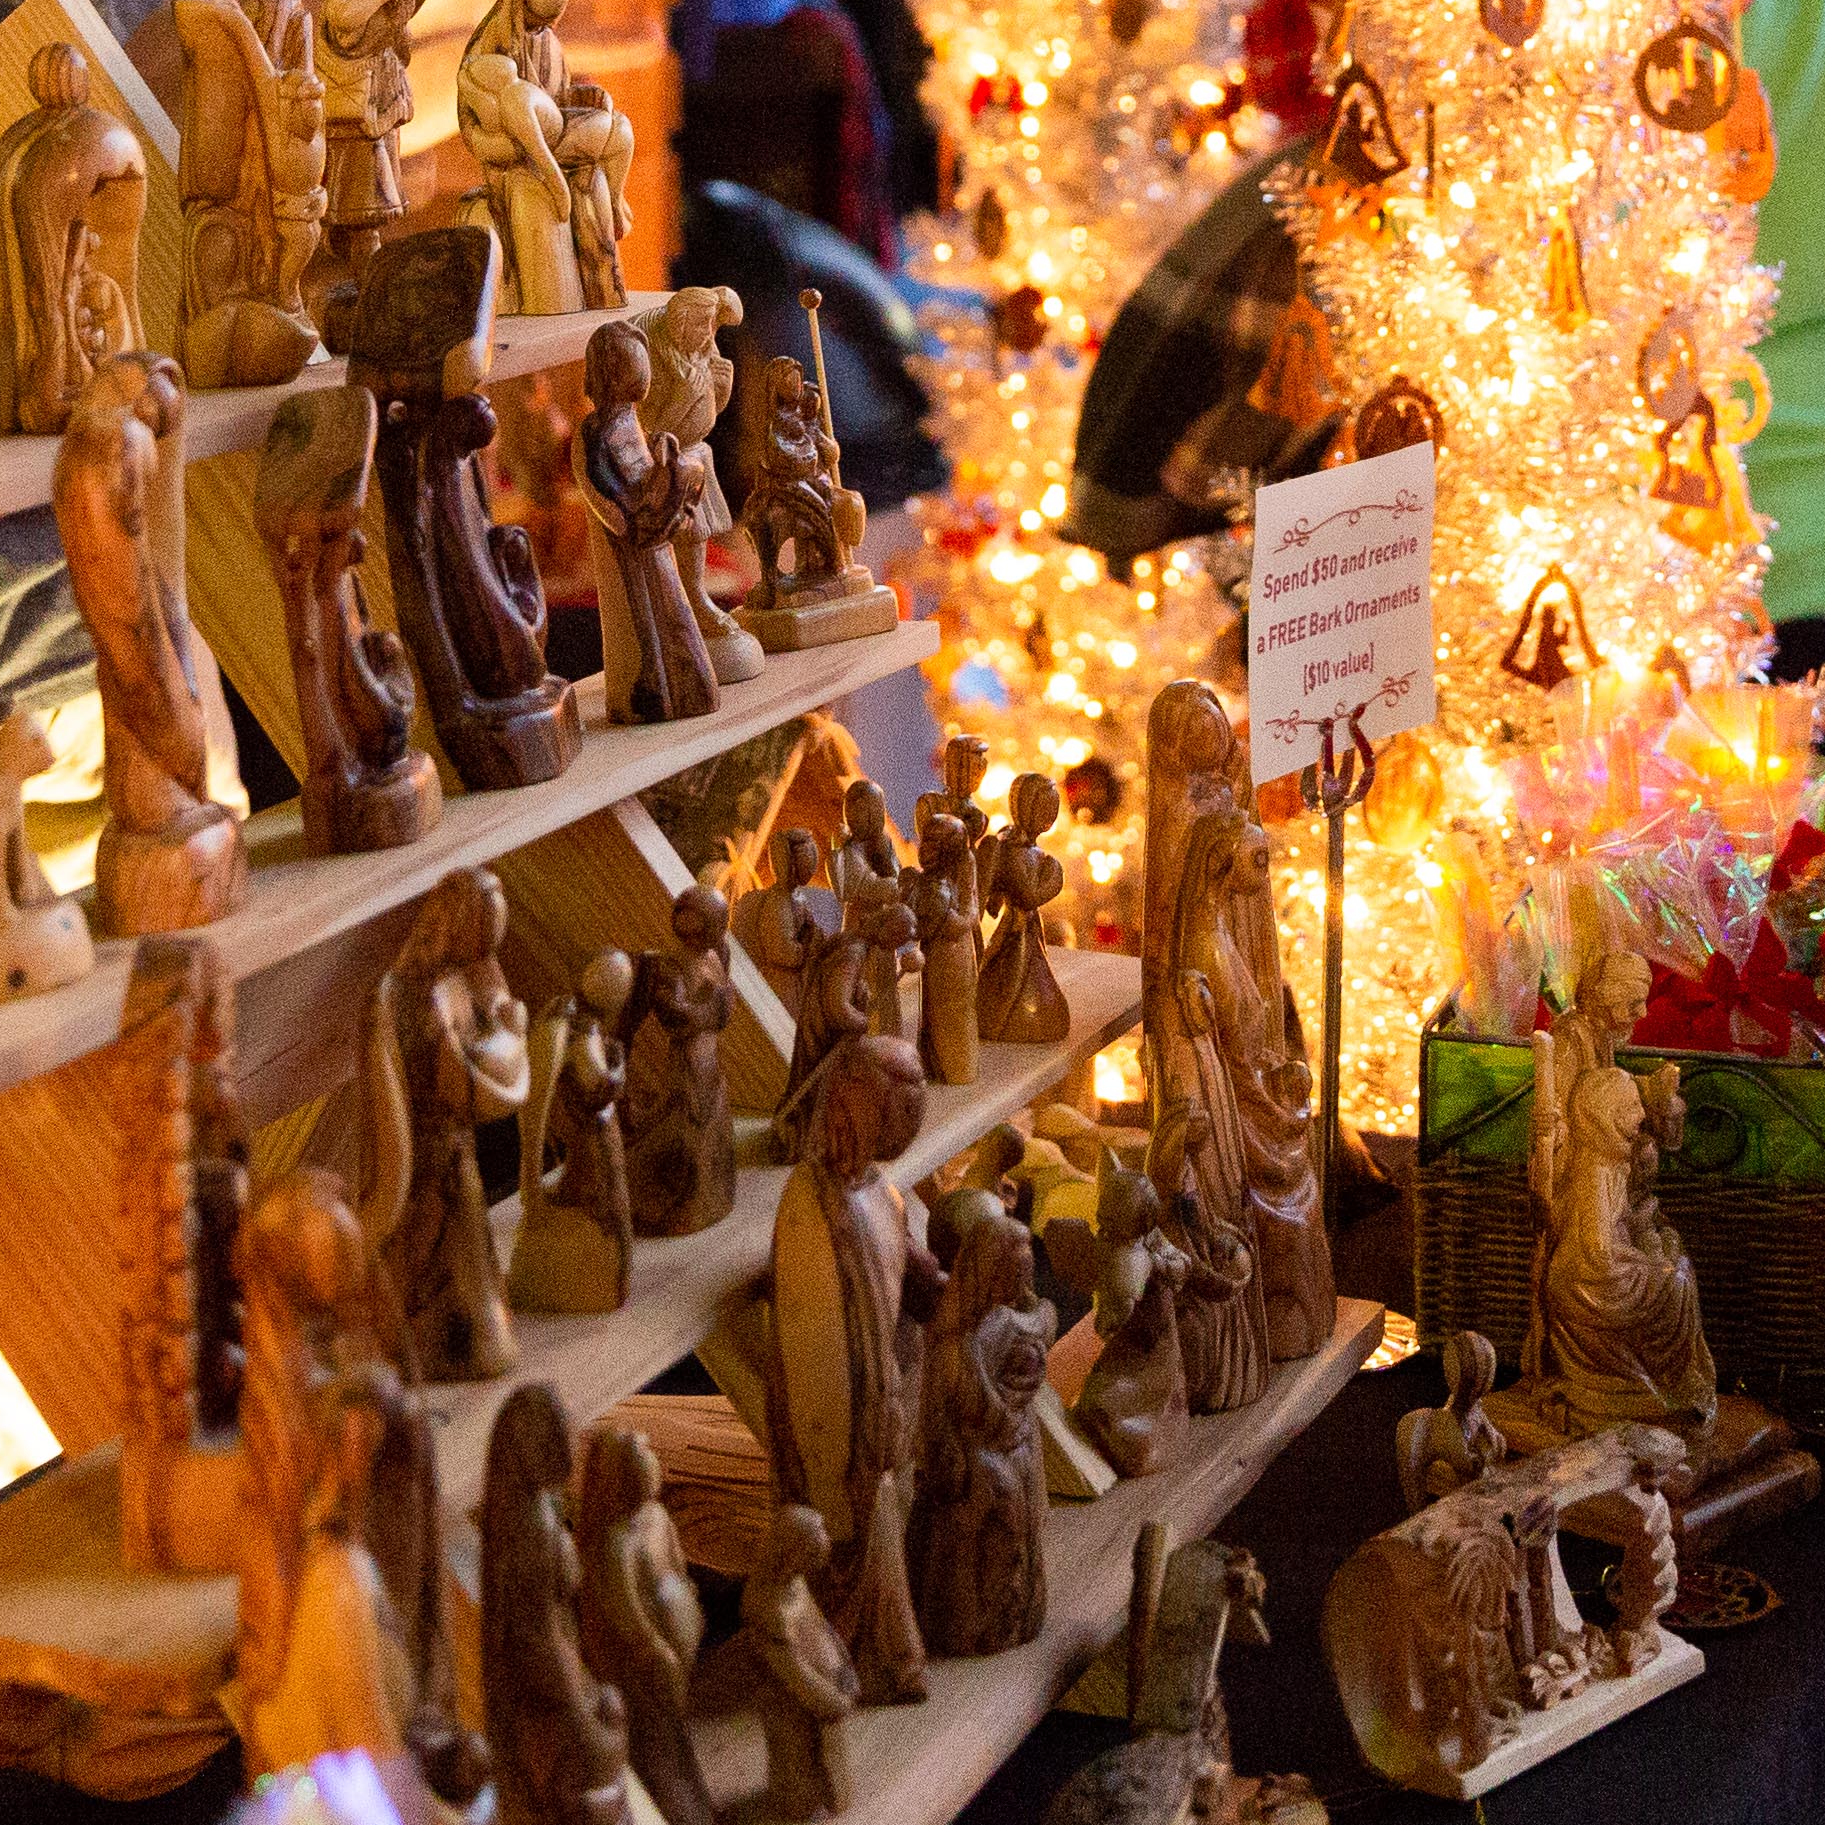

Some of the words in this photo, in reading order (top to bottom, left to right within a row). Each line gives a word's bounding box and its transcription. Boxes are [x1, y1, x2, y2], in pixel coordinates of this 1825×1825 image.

[1263, 563, 1309, 603] Spend
[1311, 554, 1338, 586] $50
[1340, 546, 1366, 576] and
[1368, 535, 1418, 567] receive
[1256, 635, 1265, 655] a
[1268, 615, 1307, 651] FREE
[1309, 605, 1342, 637] Bark
[1344, 583, 1421, 625] Ornaments
